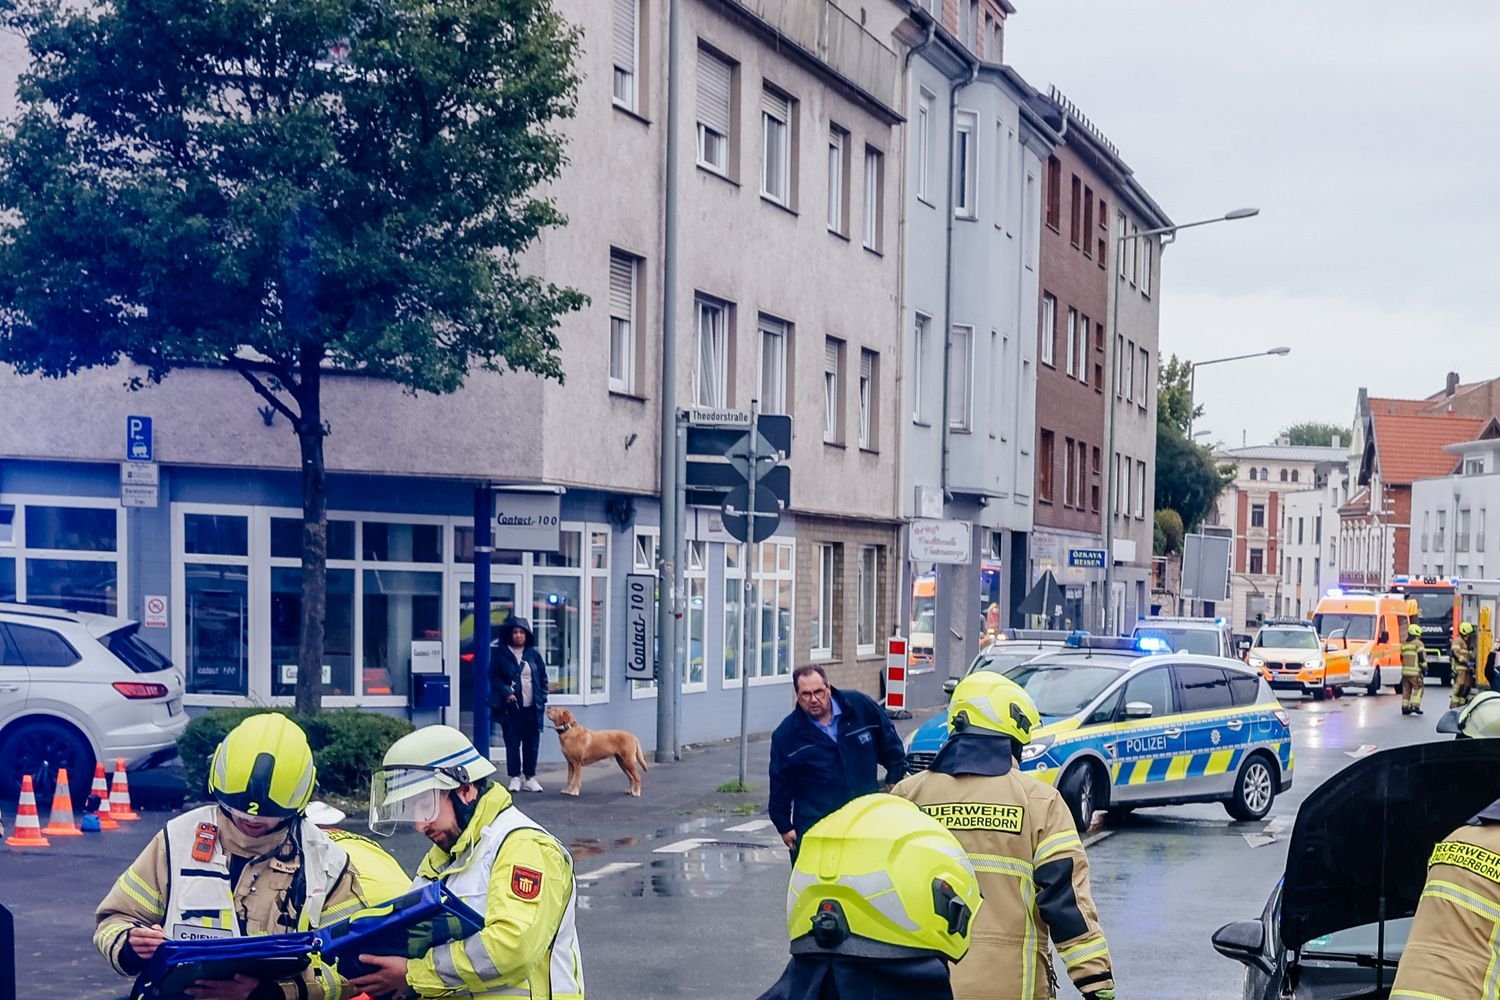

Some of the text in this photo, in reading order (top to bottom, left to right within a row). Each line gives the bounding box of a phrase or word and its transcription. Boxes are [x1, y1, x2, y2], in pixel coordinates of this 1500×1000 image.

[693, 410, 749, 422] Theodorstraße
[130, 419, 143, 439] P
[1072, 550, 1102, 559] ÖZKAYA
[1074, 558, 1101, 566] REISEN
[1126, 738, 1167, 753] POLIZEI
[247, 802, 259, 815] 2
[922, 805, 1018, 817] UERWEHR
[946, 816, 1018, 829] PADERBORN
[1447, 854, 1500, 880] PADERBORN
